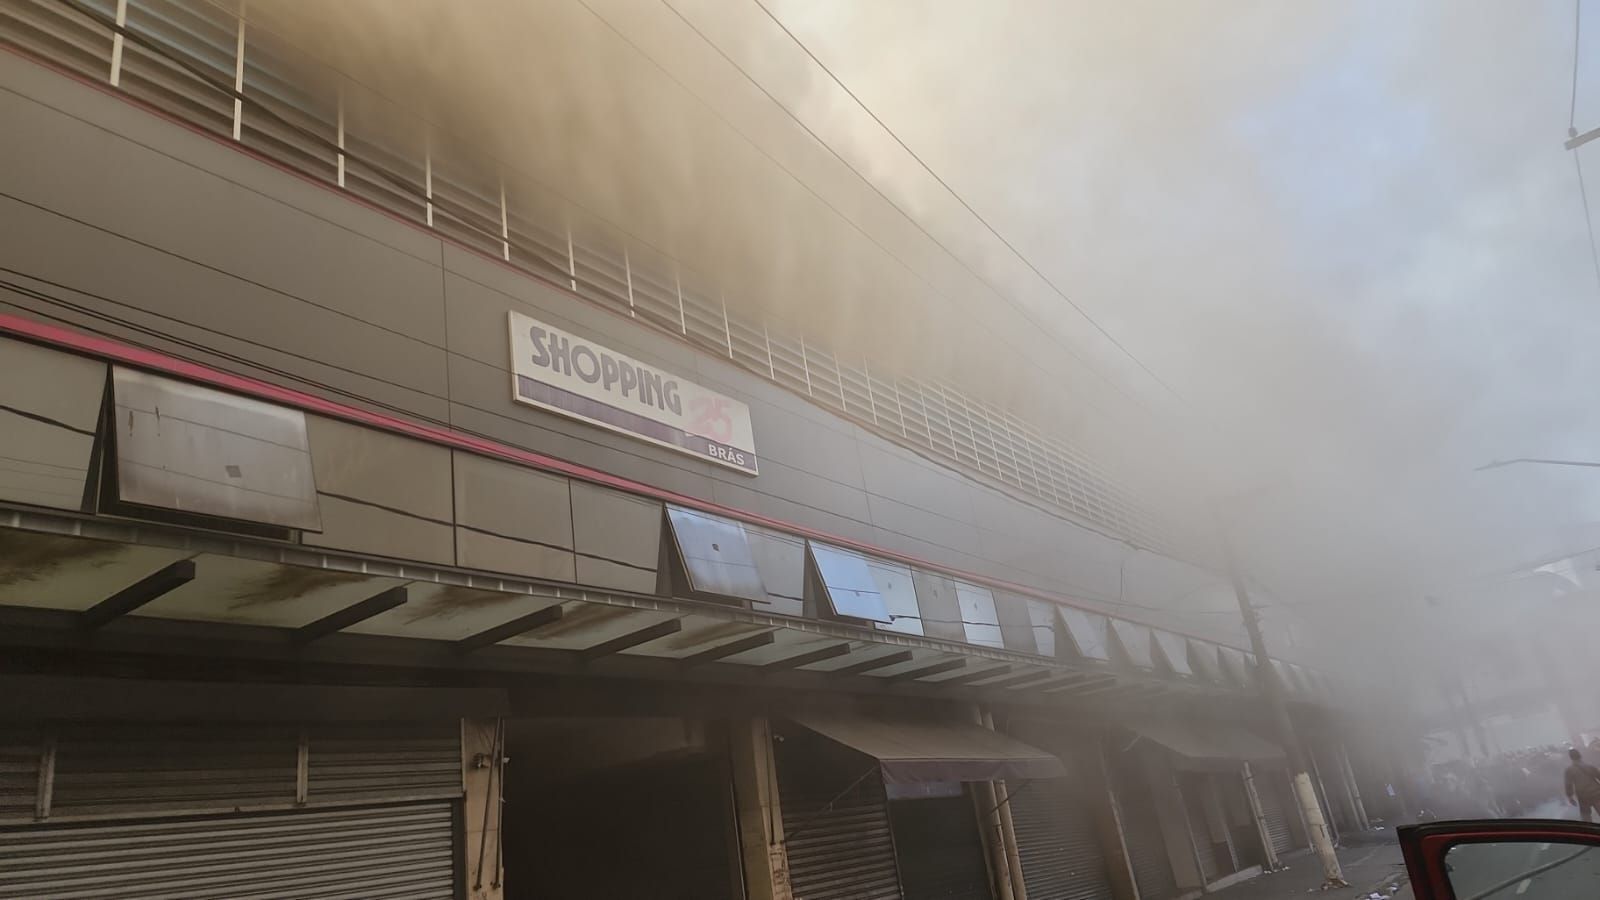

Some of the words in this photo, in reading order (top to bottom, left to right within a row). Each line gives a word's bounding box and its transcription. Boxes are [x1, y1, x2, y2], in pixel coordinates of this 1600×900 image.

[530, 326, 682, 416] SHOPPING
[687, 396, 732, 443] 25
[708, 443, 745, 466] BRÁS
